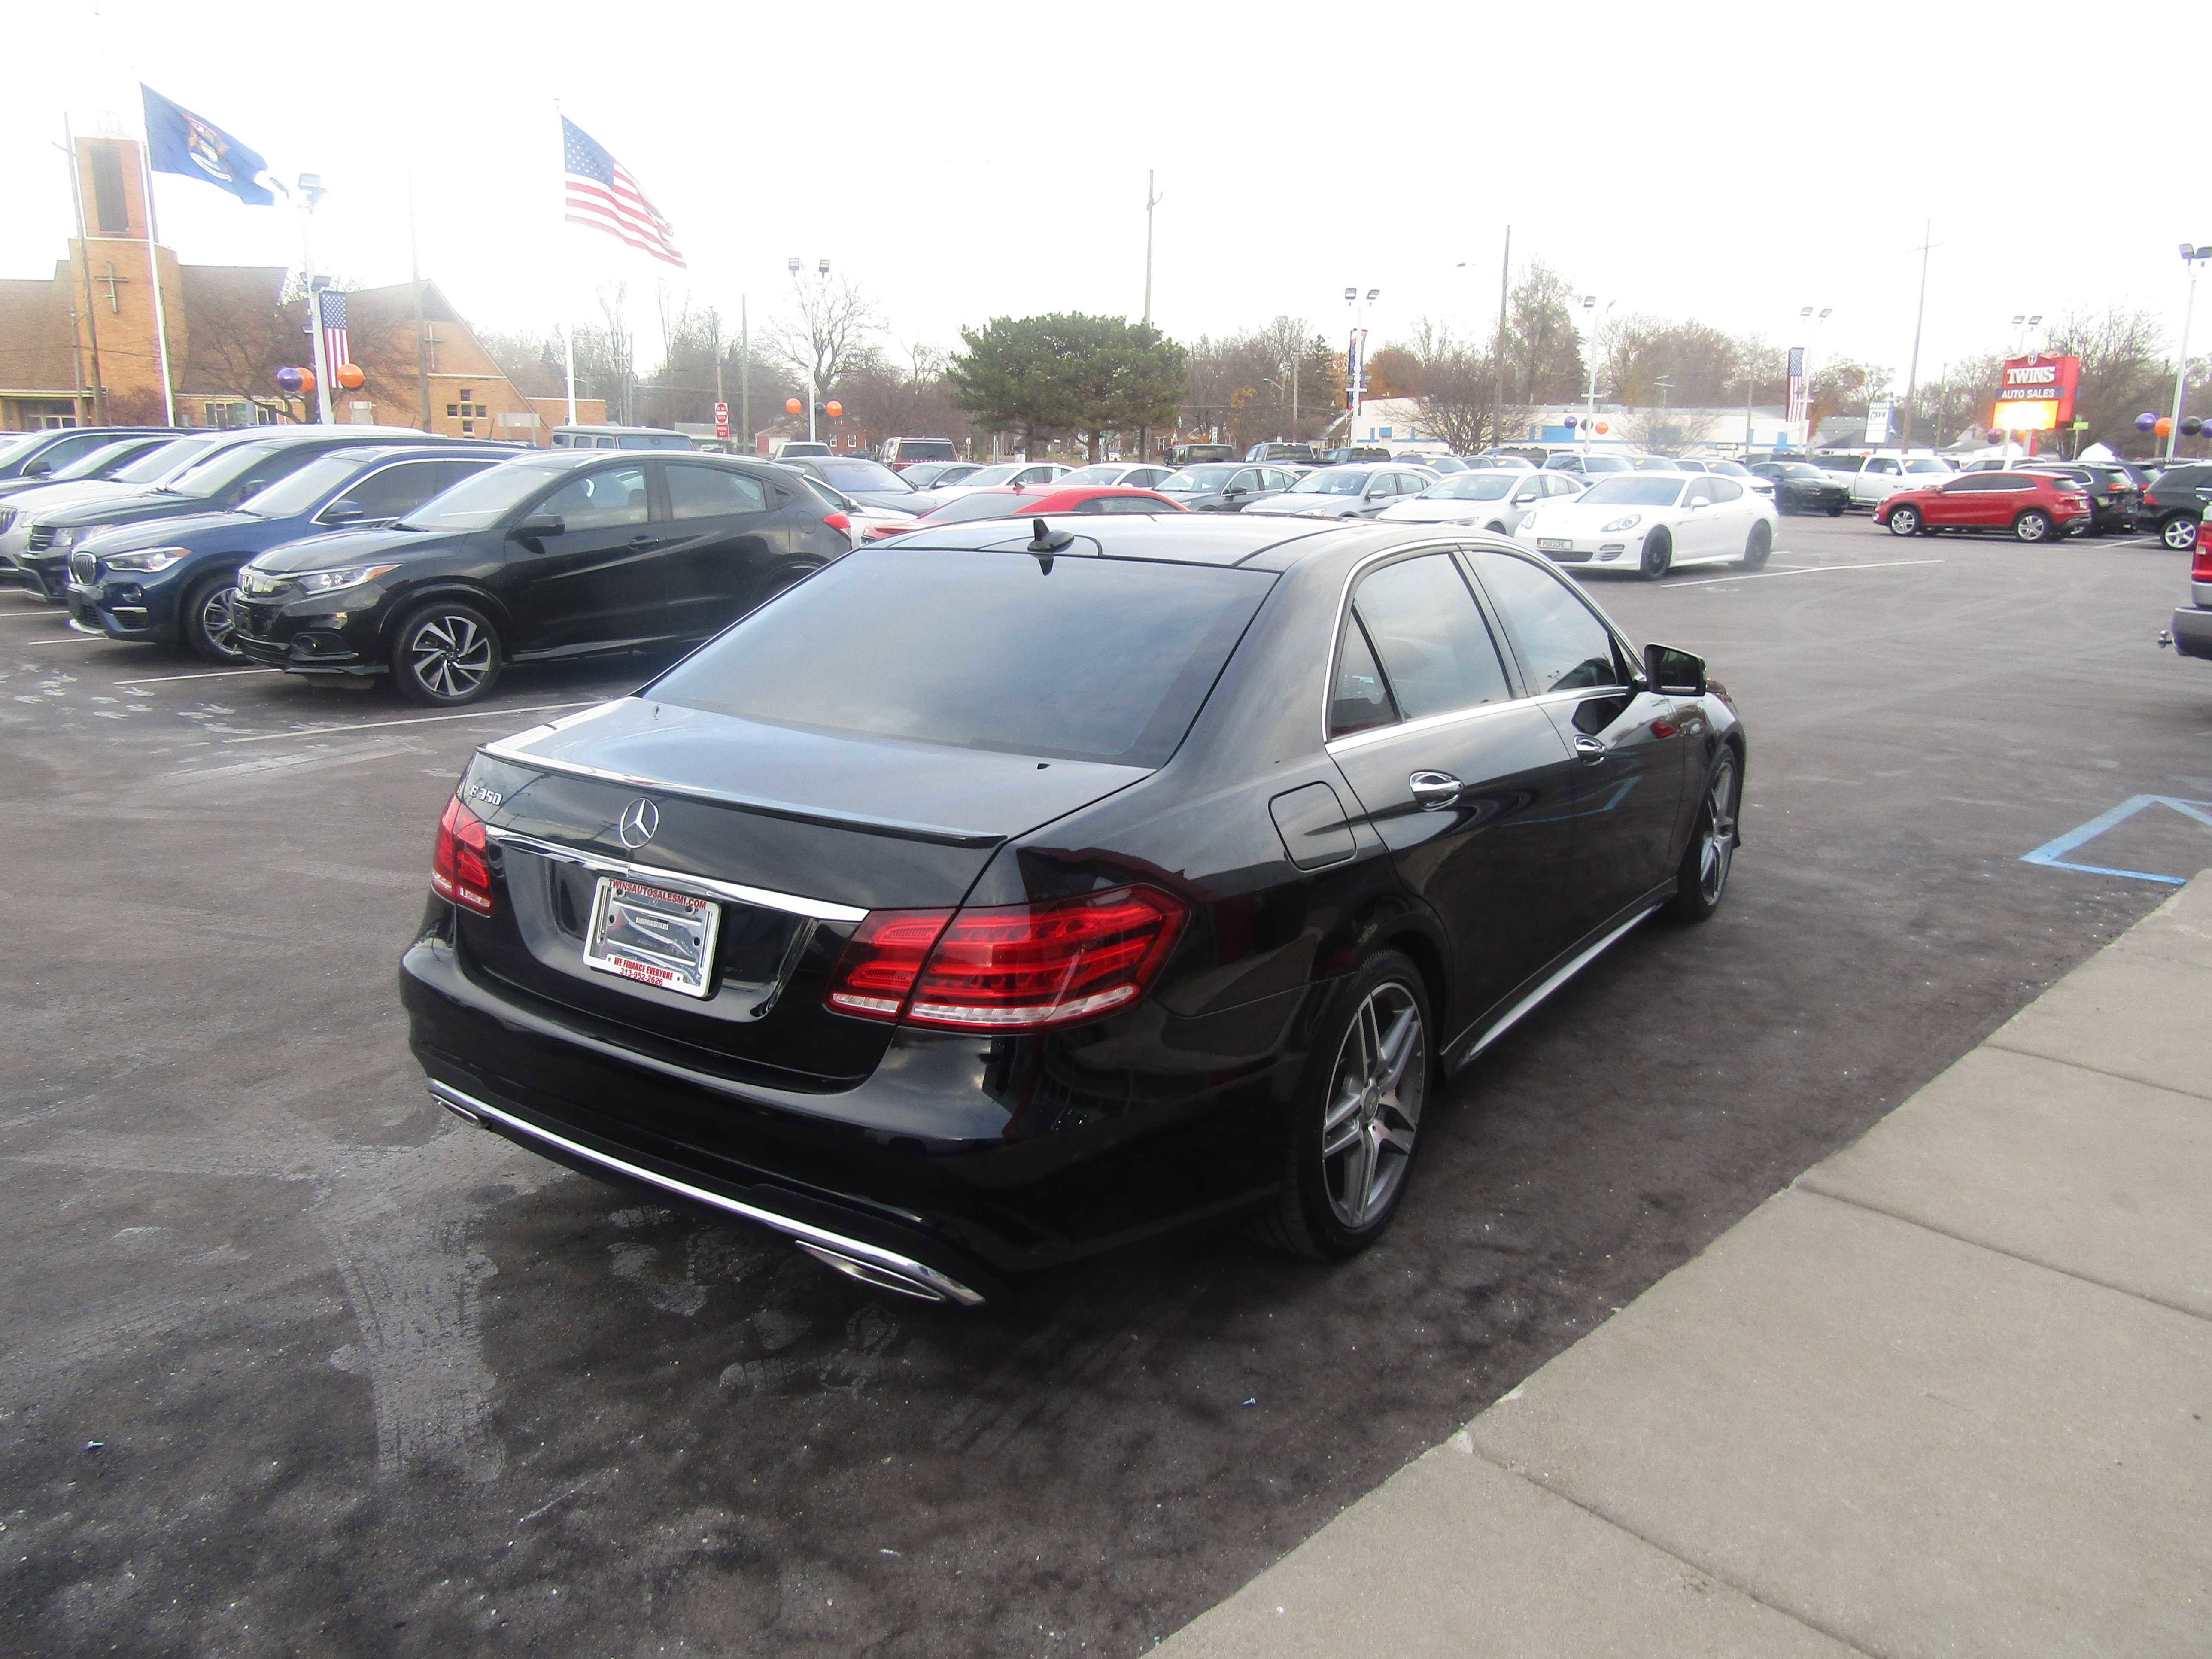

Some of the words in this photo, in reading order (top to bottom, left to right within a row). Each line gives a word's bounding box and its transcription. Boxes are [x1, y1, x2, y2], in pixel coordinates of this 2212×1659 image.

[2007, 366, 2056, 384] TWINS
[2002, 389, 2024, 399] AUTO
[2027, 389, 2054, 398] SALES
[609, 879, 707, 910] TWINSAUTOSALESMI.COM
[614, 957, 623, 966] WE
[623, 960, 646, 972] FINANCE
[646, 966, 673, 980] EVERYONE
[620, 967, 663, 986] 313-952-2626
